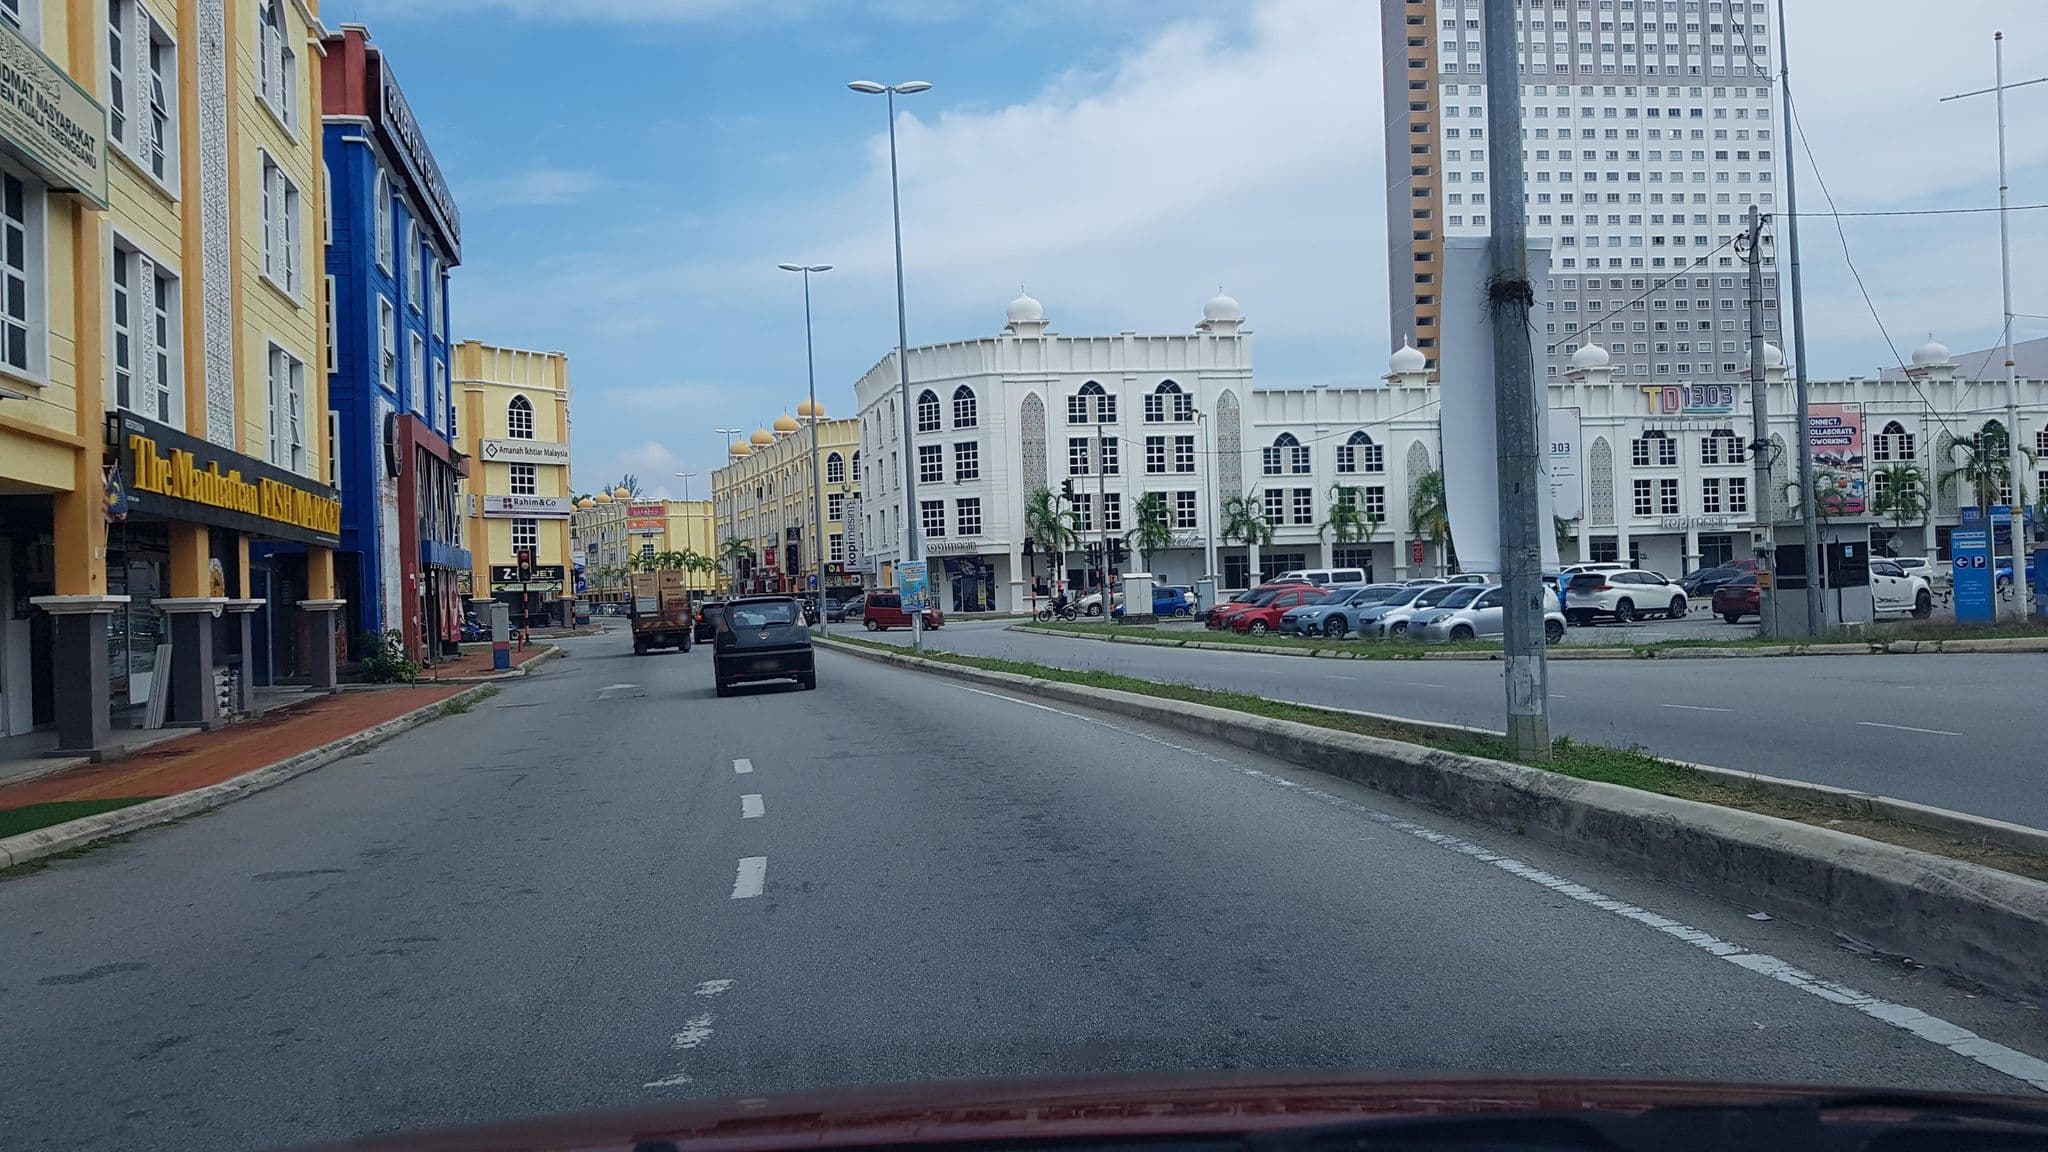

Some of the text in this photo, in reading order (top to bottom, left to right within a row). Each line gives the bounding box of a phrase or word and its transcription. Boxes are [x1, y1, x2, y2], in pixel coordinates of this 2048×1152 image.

[37, 91, 95, 153] MASYARAKAT
[17, 93, 45, 129] KUALA
[46, 120, 96, 170] TERENGGANU
[1643, 385, 1733, 414] TD1303
[1809, 418, 1840, 427] ONNECT.
[1809, 428, 1855, 436] OLLABORATE.
[1810, 438, 1851, 446] OWORKING.
[499, 446, 568, 459] Amanah Ikhtiar Malaysia
[129, 434, 340, 536] The Manhattan FISH MARKET
[514, 498, 557, 507] Rahim&Co
